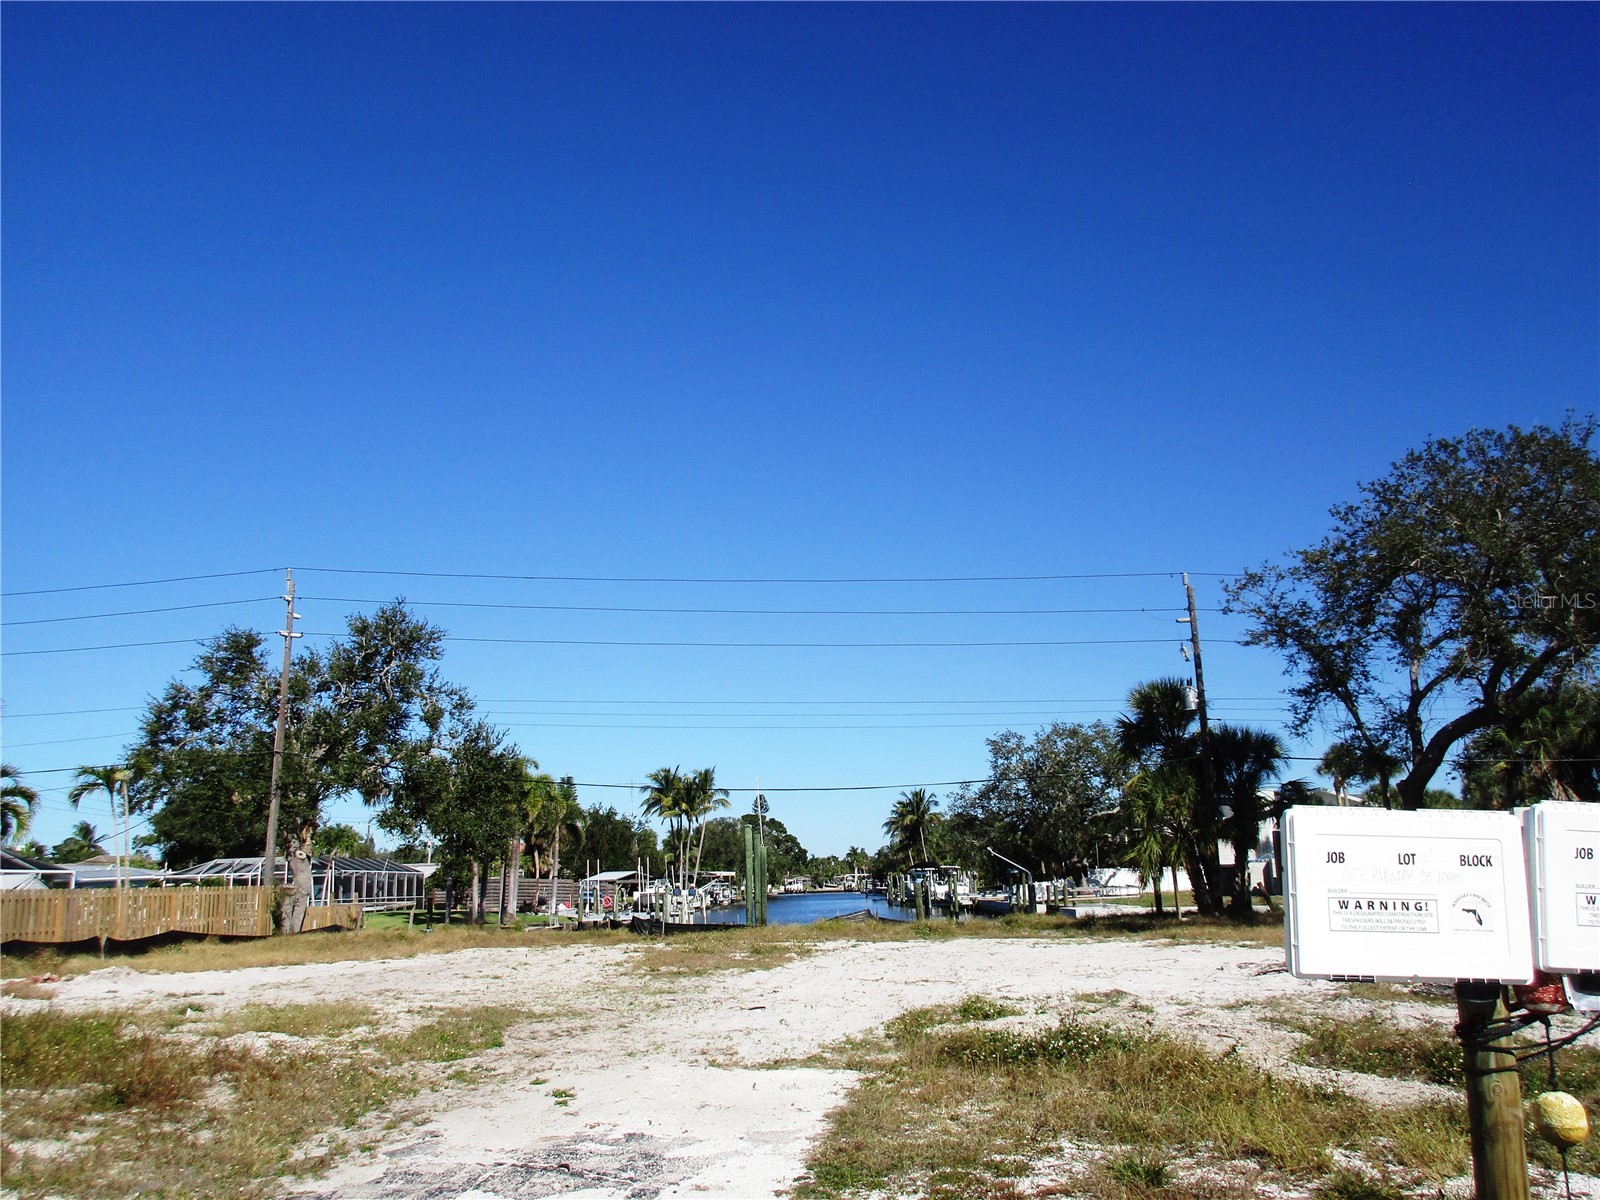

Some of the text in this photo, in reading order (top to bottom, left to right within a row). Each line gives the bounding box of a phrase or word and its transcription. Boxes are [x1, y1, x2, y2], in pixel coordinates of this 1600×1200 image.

[1326, 852, 1493, 867] JOB LOT BLOCK
[1574, 847, 1594, 860] JOB
[1338, 900, 1429, 911] WARNING!
